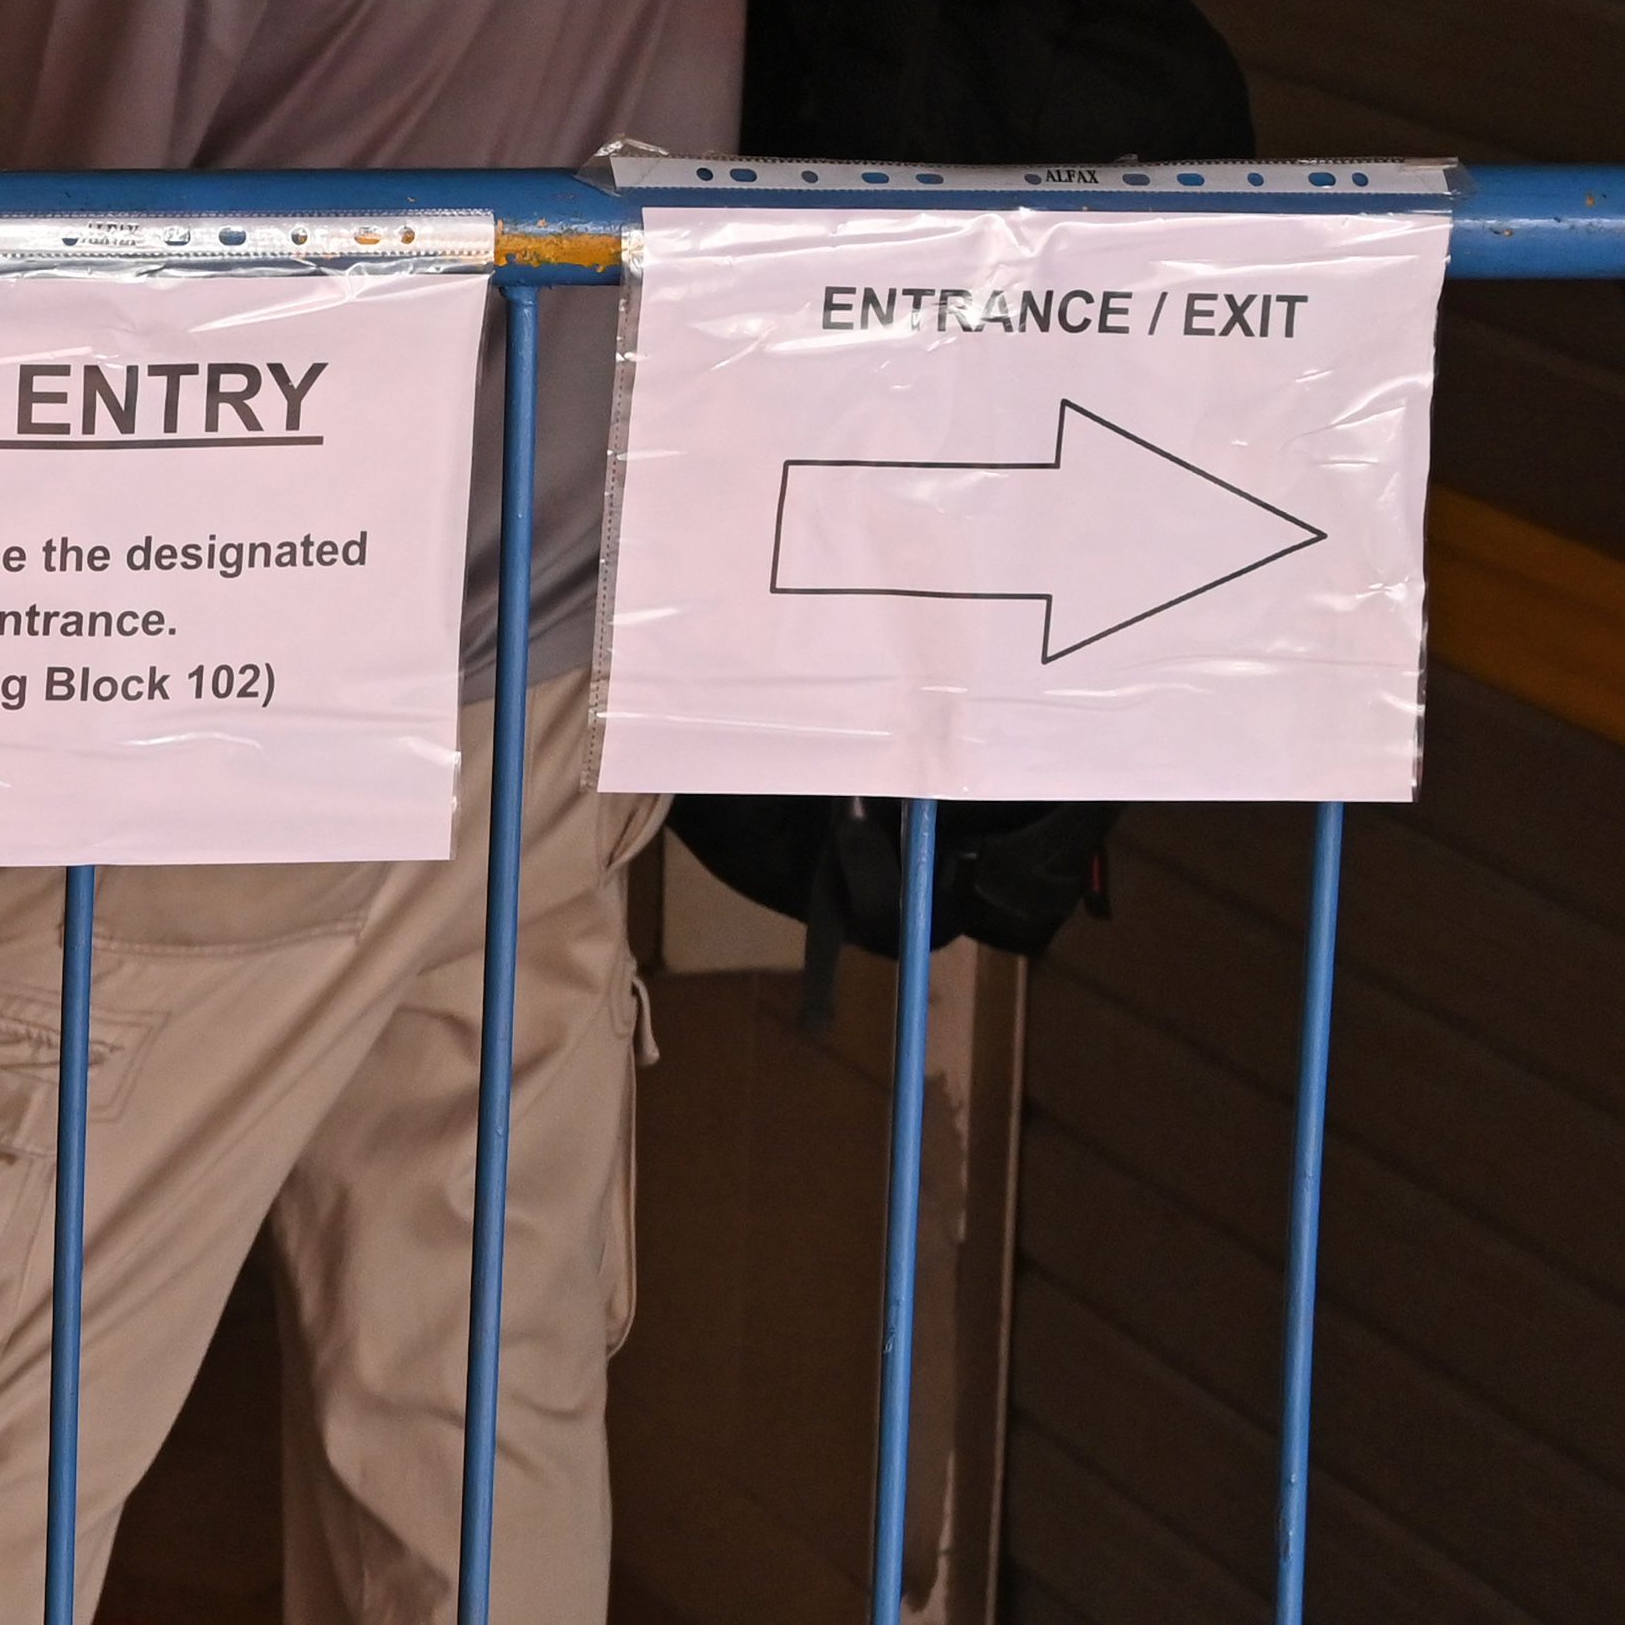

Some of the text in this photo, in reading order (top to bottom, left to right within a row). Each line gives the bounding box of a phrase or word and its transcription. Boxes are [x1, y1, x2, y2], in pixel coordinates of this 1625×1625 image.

[1045, 169, 1099, 185] ALFAX
[822, 285, 1309, 338] ENTRANCE / EXIT
[16, 362, 329, 451] ENTRY
[42, 536, 111, 573] the
[126, 530, 368, 579] designated
[45, 665, 171, 703] Block
[187, 662, 275, 708] 102)
